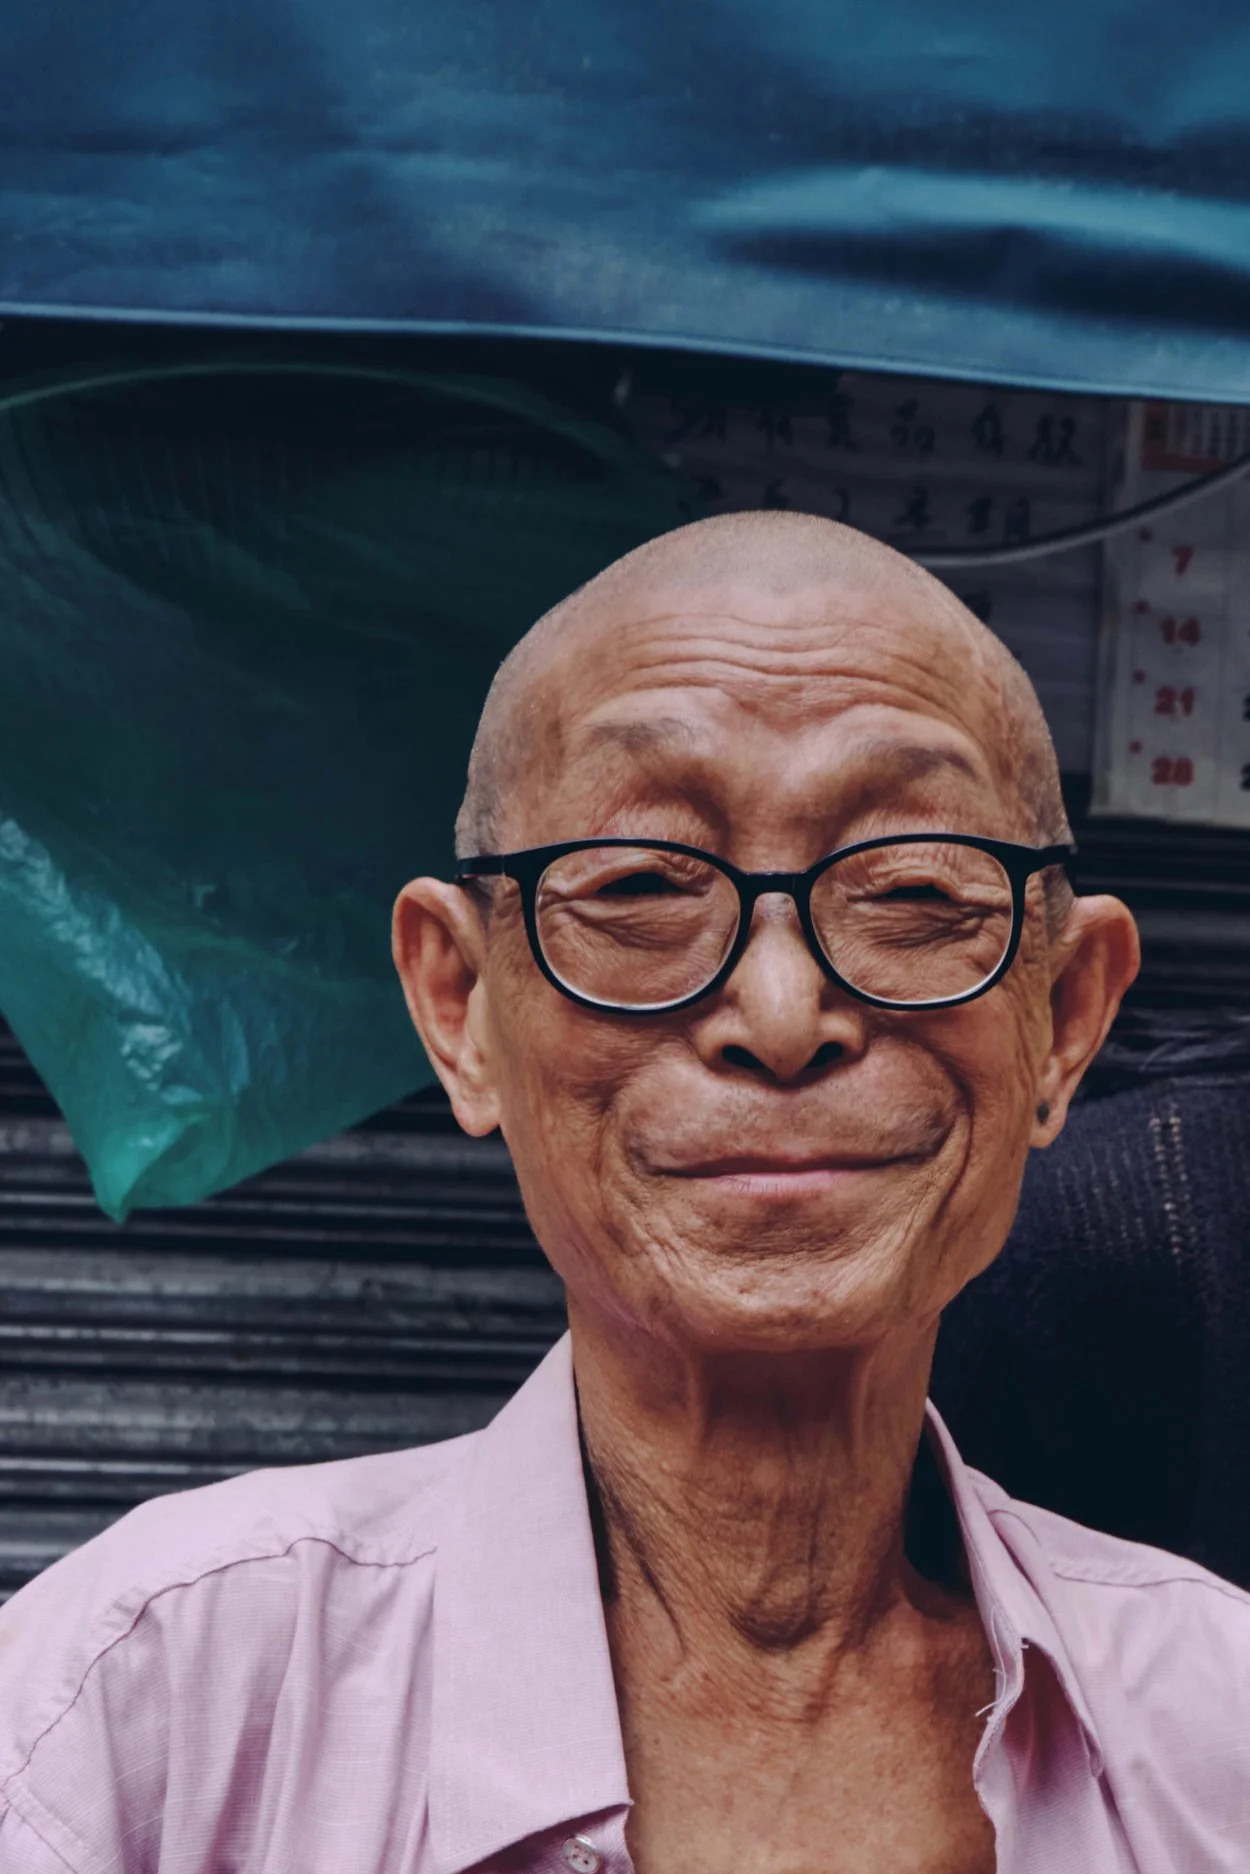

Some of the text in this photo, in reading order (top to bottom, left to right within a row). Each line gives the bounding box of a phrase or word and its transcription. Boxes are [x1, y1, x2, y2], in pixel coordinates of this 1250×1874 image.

[1172, 545, 1195, 577] 7
[1160, 616, 1201, 647] 14
[1154, 685, 1195, 717] 21
[1151, 756, 1194, 786] 28
